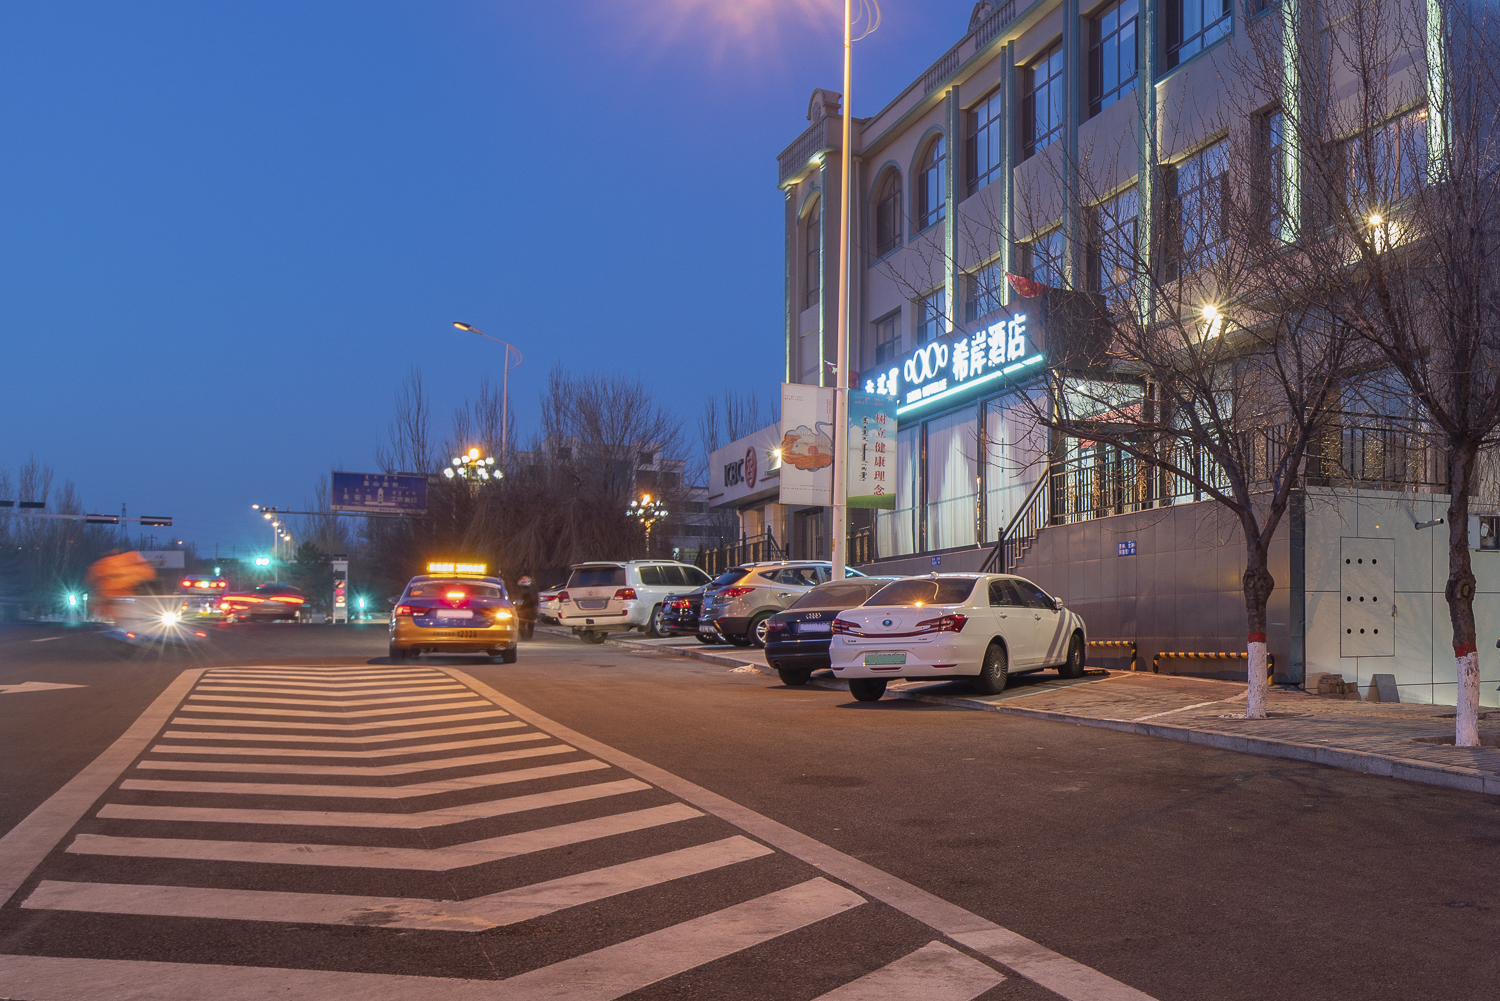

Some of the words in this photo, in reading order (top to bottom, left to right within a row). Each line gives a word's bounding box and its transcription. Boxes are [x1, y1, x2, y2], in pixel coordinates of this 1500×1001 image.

[952, 313, 1027, 382] 希岸酒店
[724, 458, 745, 488] ICBC
[873, 413, 887, 496] 树立健康理念
[457, 630, 478, 638] 12328
